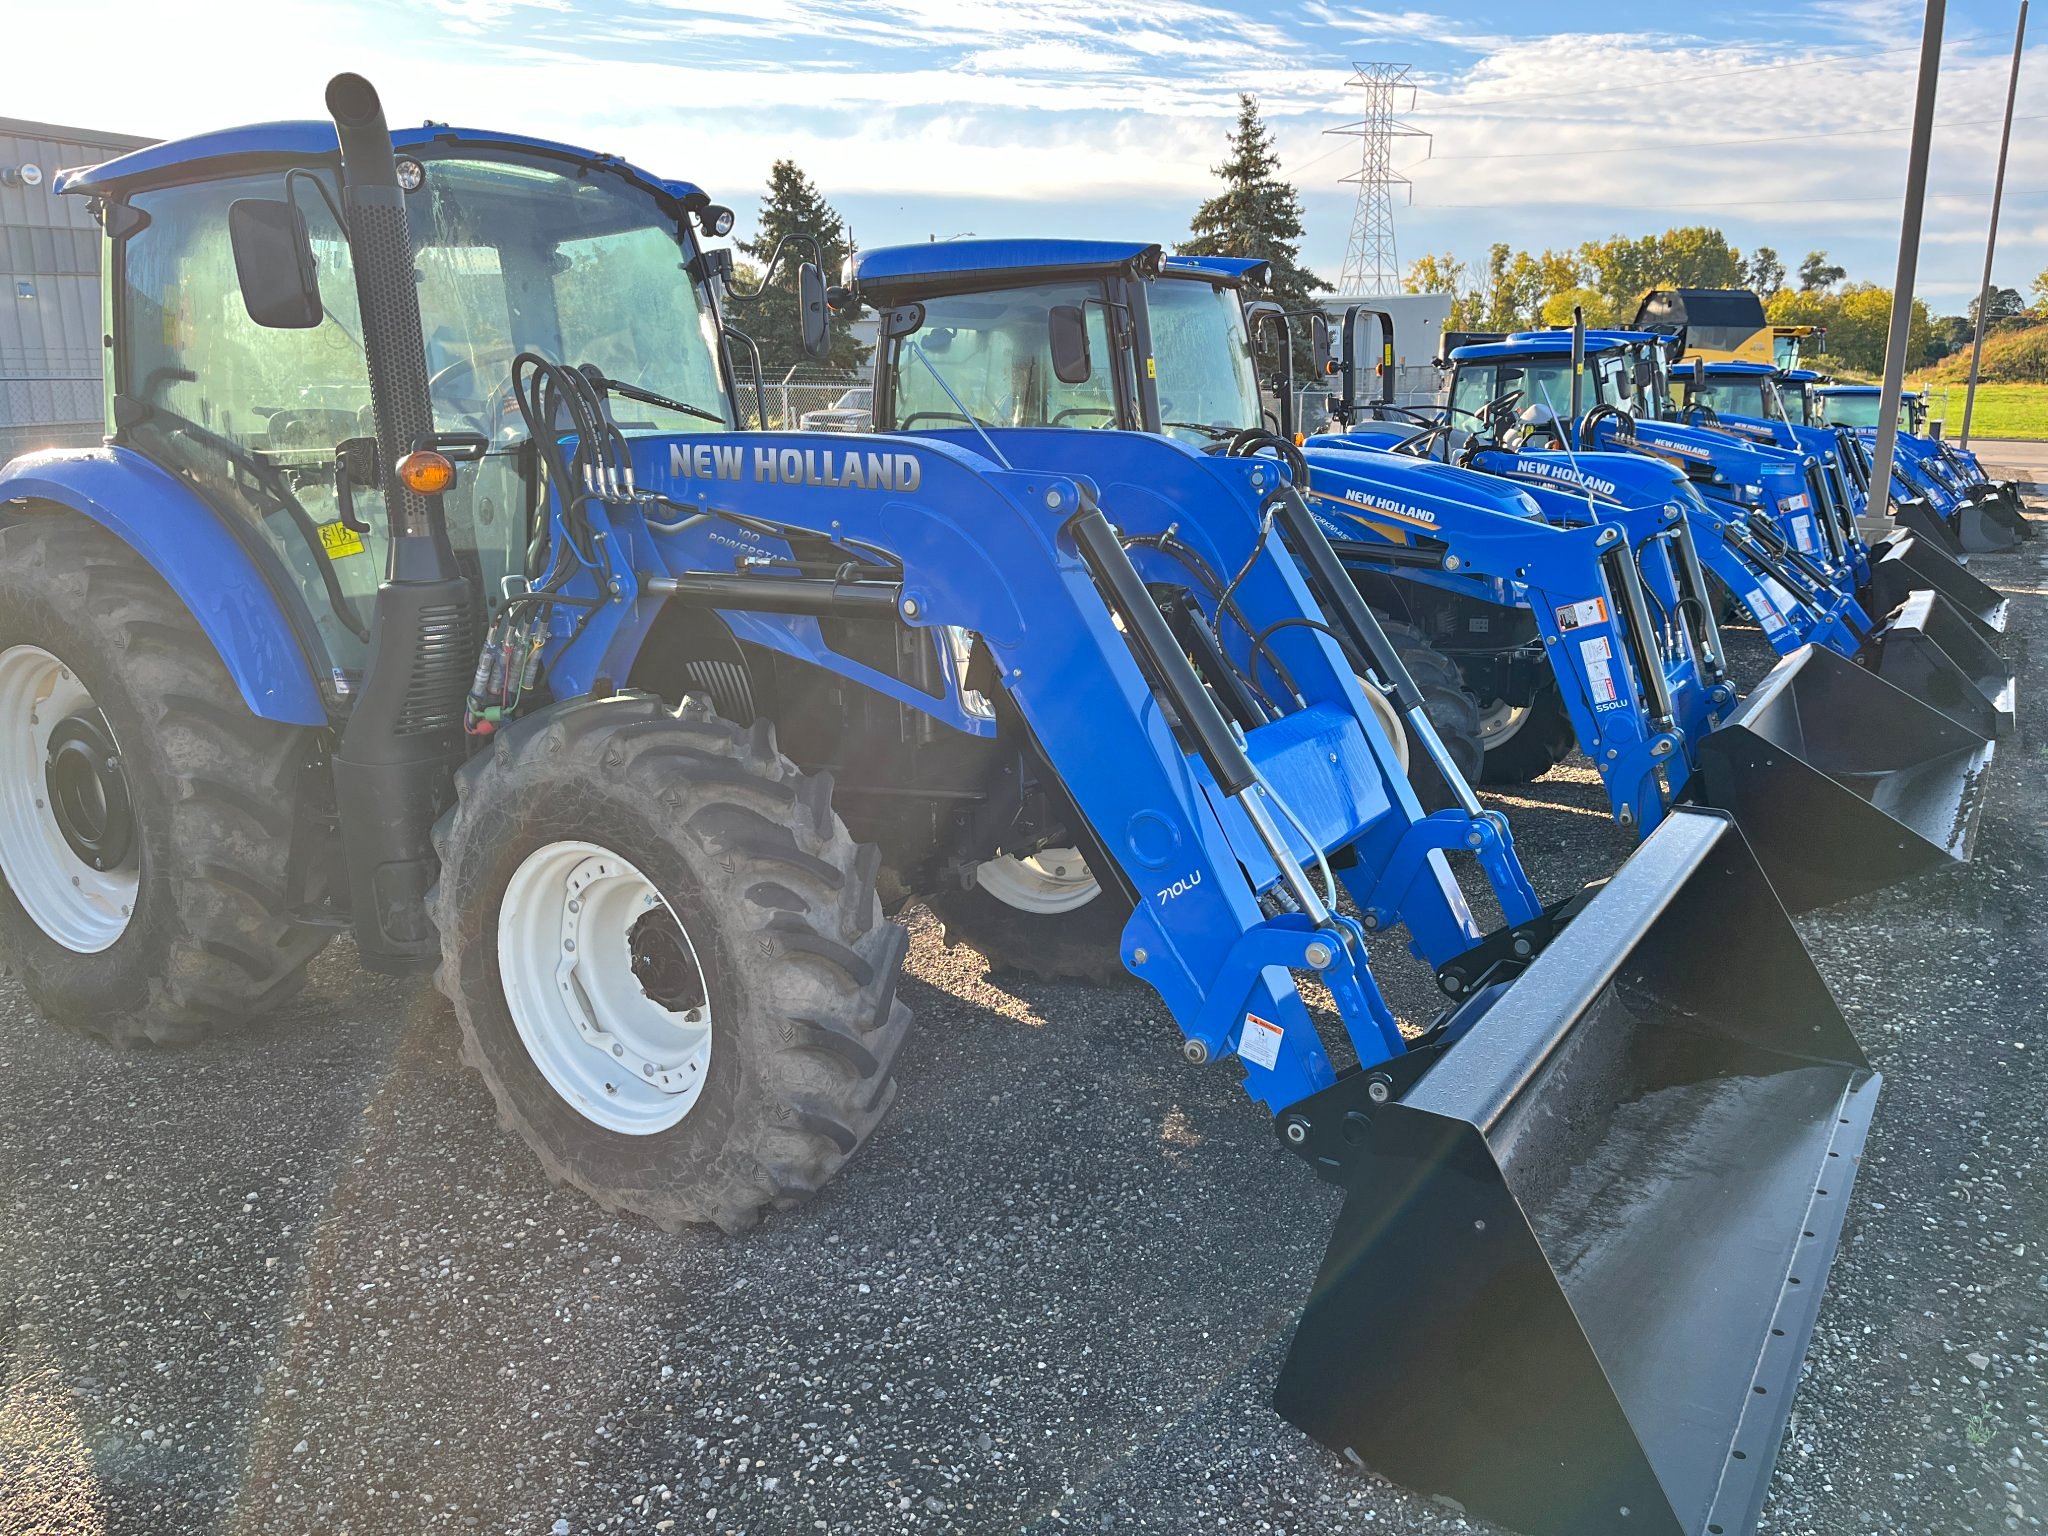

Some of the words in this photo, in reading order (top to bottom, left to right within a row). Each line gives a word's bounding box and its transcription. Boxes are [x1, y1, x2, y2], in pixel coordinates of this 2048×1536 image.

[1655, 438, 1673, 448] NEW
[1673, 442, 1710, 456] HOLLAND
[669, 443, 743, 480] NEW
[753, 447, 921, 492] HOLLAND
[1517, 460, 1550, 476] NEW
[1551, 466, 1616, 495] HOLLAND
[1345, 489, 1376, 506] NEW
[1376, 497, 1435, 523] HOLLAND
[738, 528, 760, 542] 100
[1595, 699, 1628, 713] 550LU
[1157, 869, 1201, 905] 710LU
